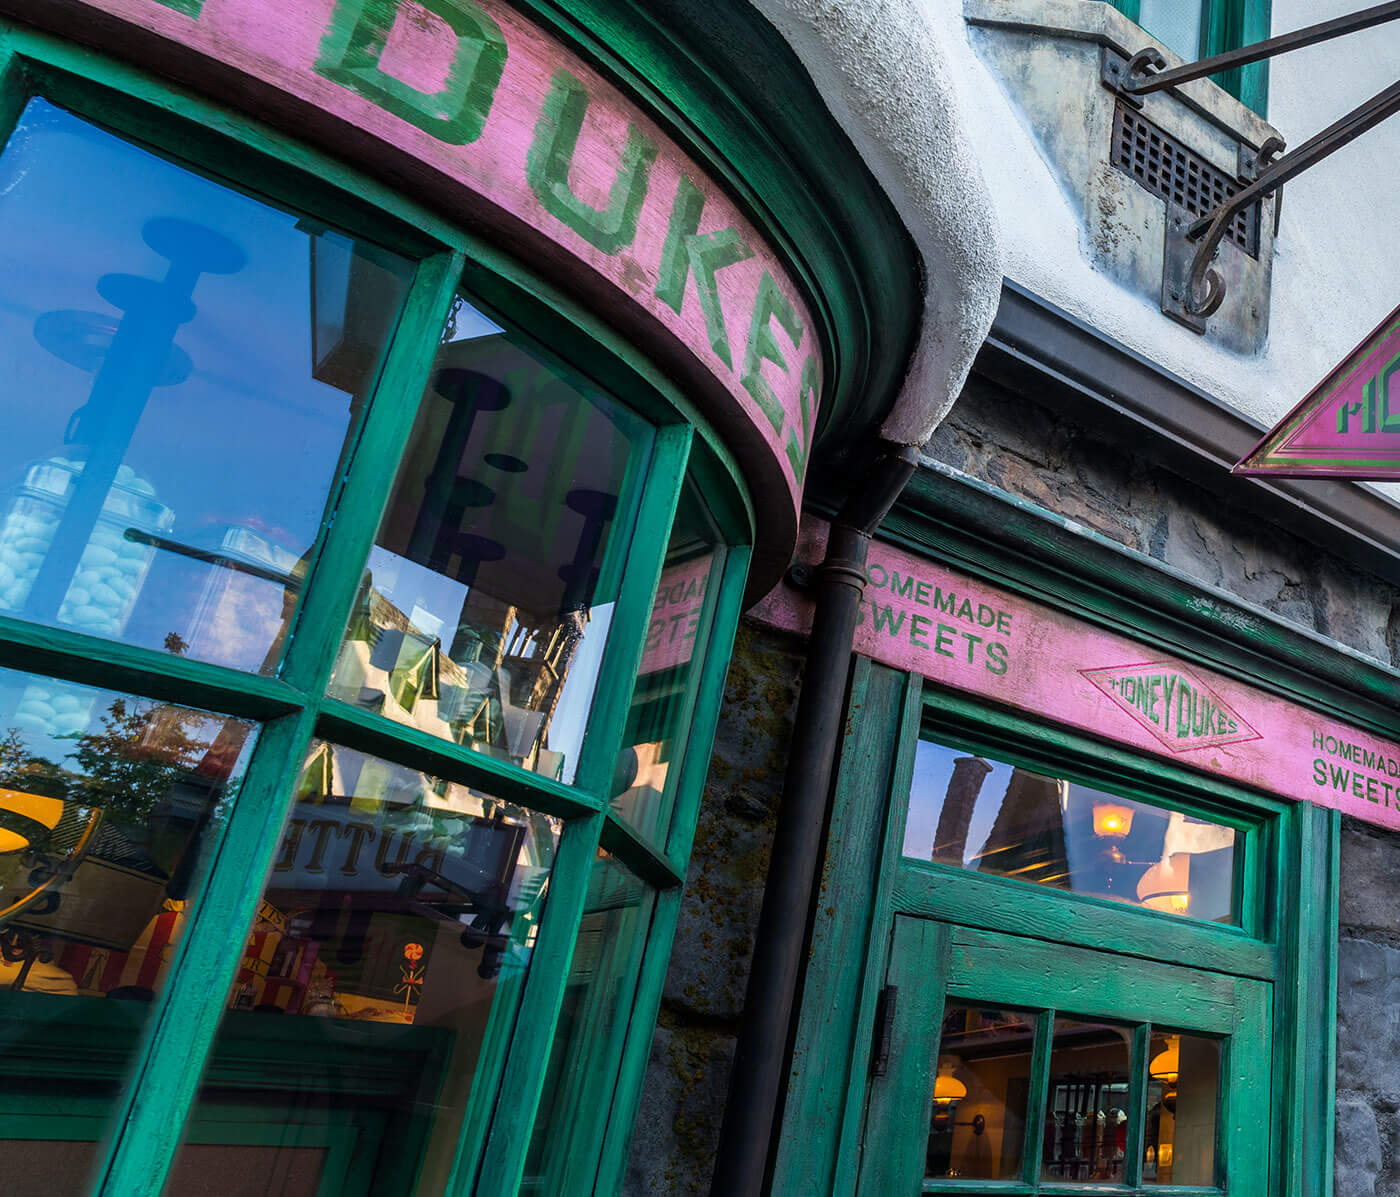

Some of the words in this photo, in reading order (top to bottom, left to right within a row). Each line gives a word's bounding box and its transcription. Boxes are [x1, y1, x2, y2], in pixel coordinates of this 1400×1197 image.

[162, 0, 821, 486] DUKES
[866, 563, 1013, 636] OMEMADE
[1109, 674, 1238, 738] HONEYDUKES
